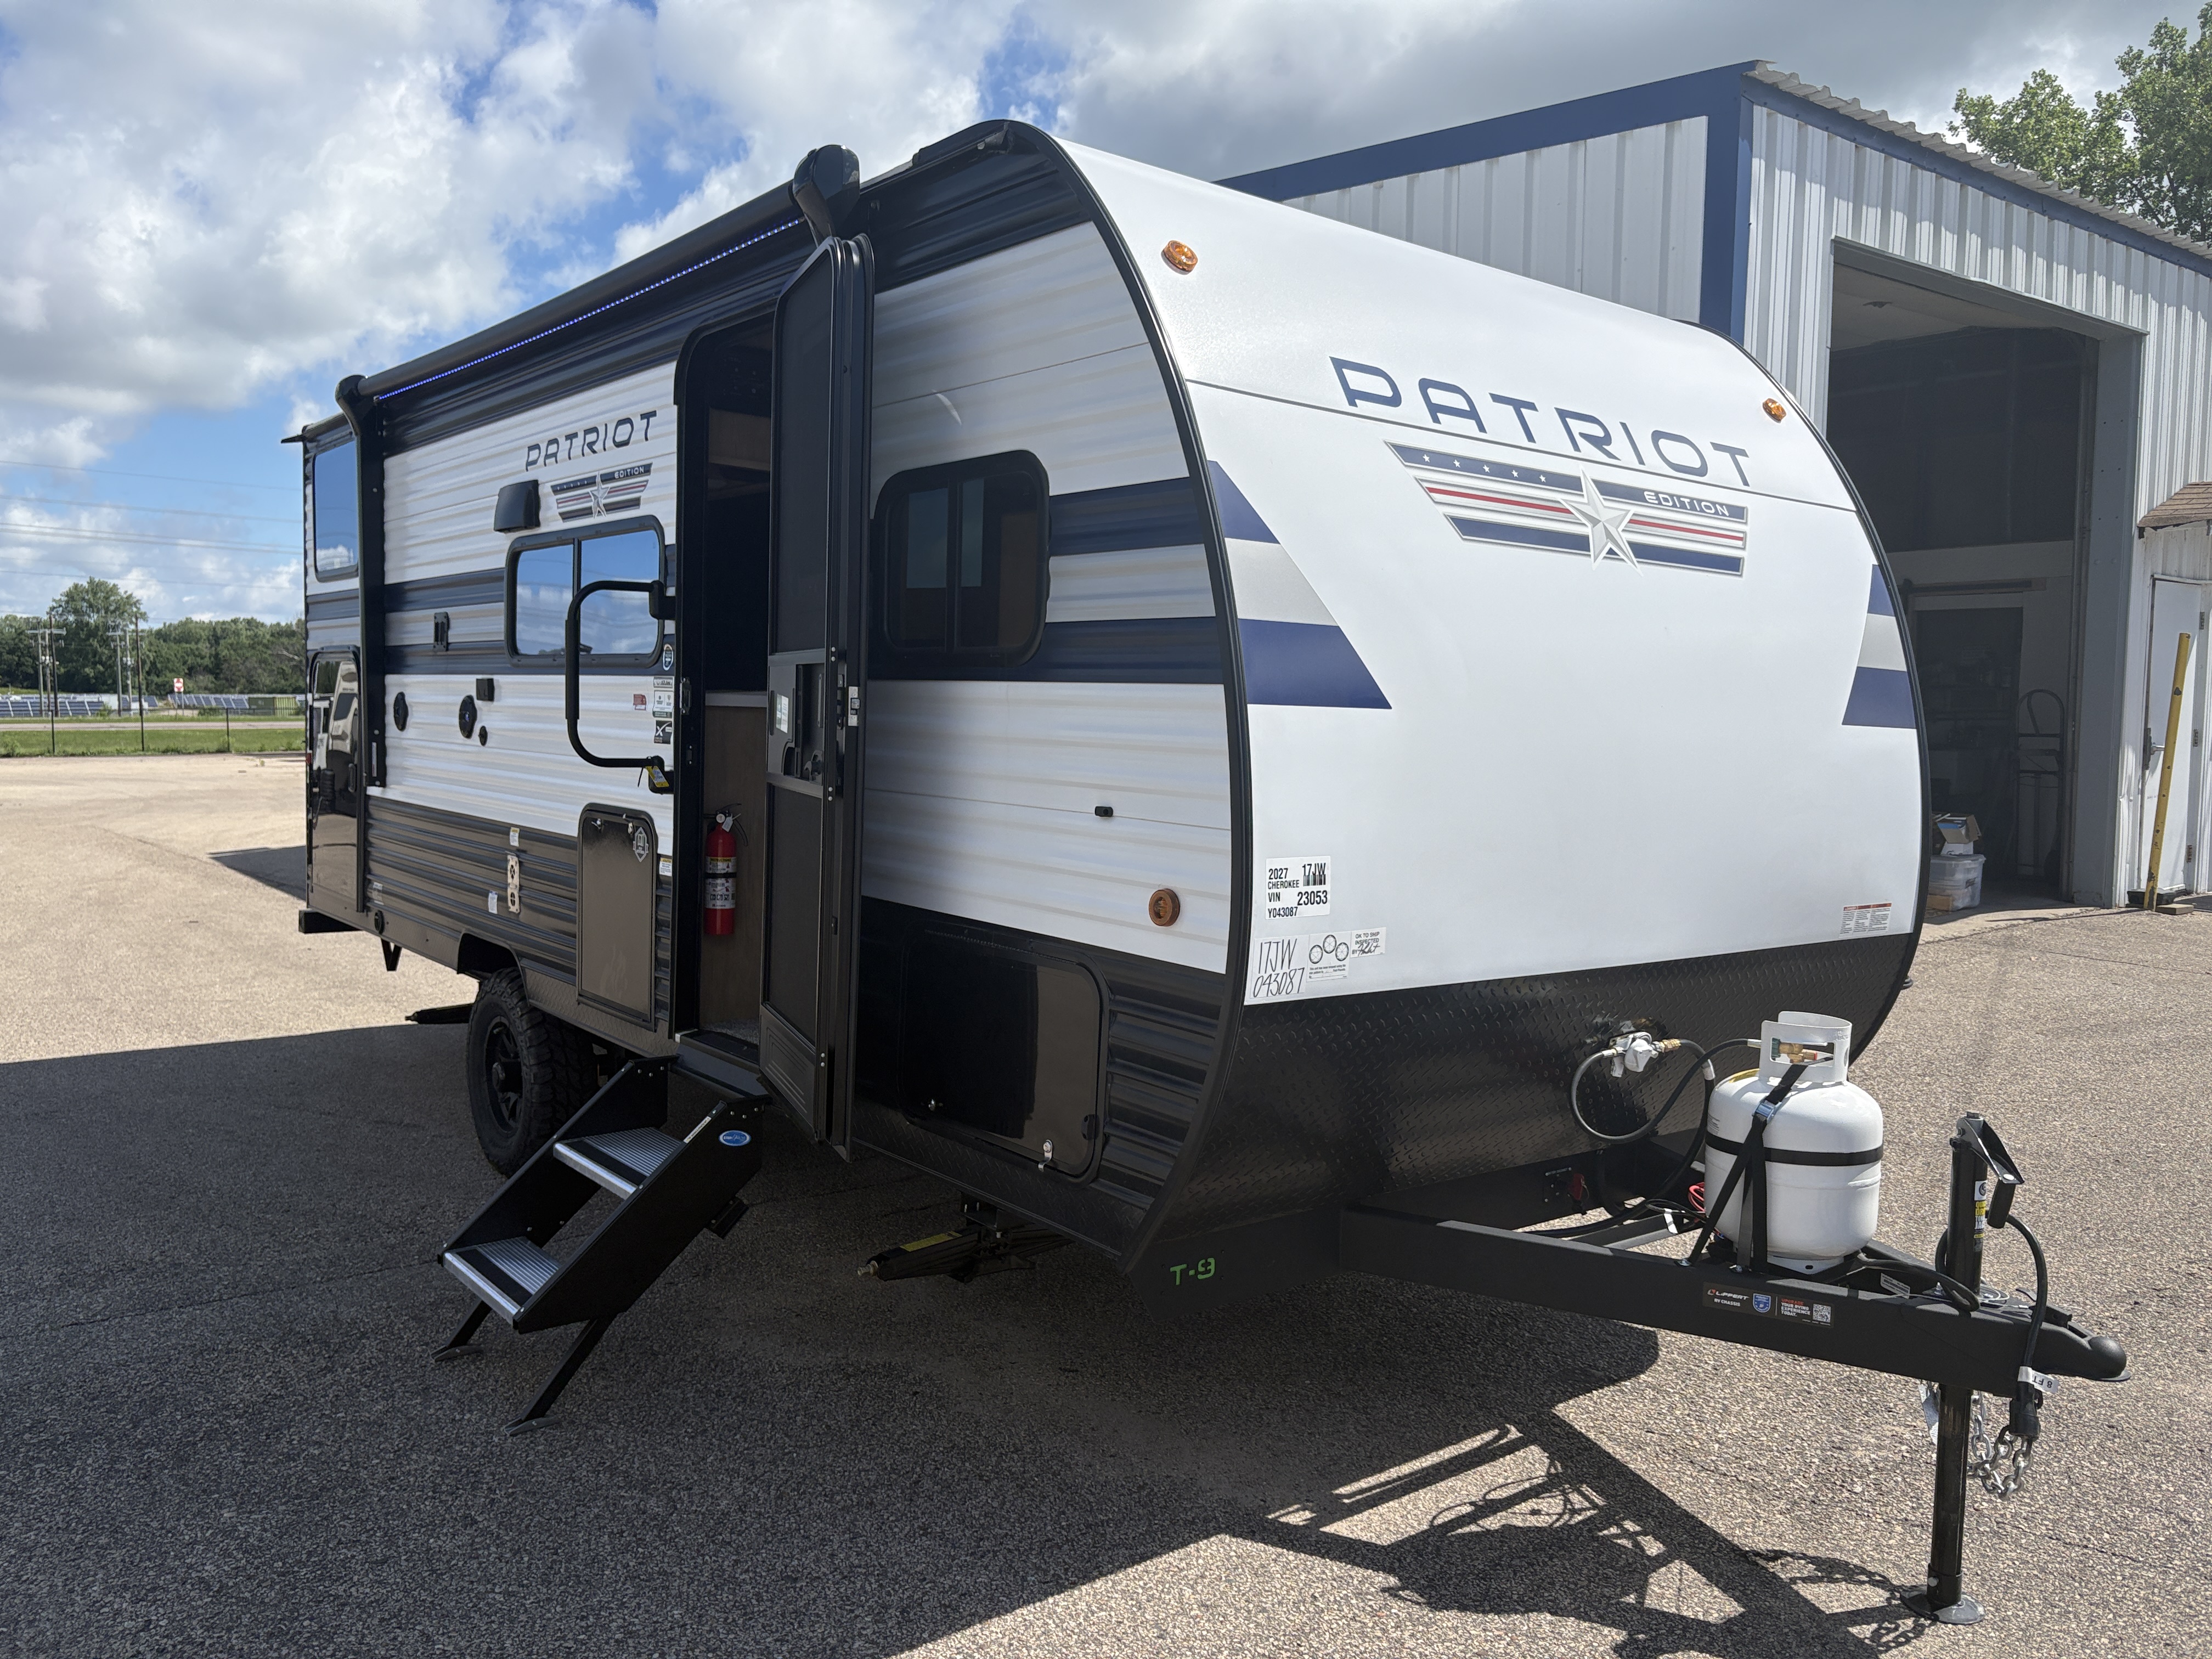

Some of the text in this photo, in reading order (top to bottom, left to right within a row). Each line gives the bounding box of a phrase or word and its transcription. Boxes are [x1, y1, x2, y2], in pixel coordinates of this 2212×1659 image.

[1329, 356, 1750, 487] PATRIOT
[526, 410, 657, 472] PATRIOT
[614, 466, 645, 479] EDITION
[1643, 490, 1729, 517] EDITION
[1268, 862, 1326, 879] 2027 17JW
[1268, 880, 1300, 889] CHEROKEE
[1268, 890, 1328, 906] VIN 23053
[1268, 906, 1298, 918] Y043087
[1258, 938, 1297, 974] 17JW
[1254, 967, 1305, 997] 043087
[1170, 1257, 1215, 1285] T-9
[1781, 1306, 1811, 1315] EXPERIENCE
[2032, 1375, 2053, 1389] 8 FT
